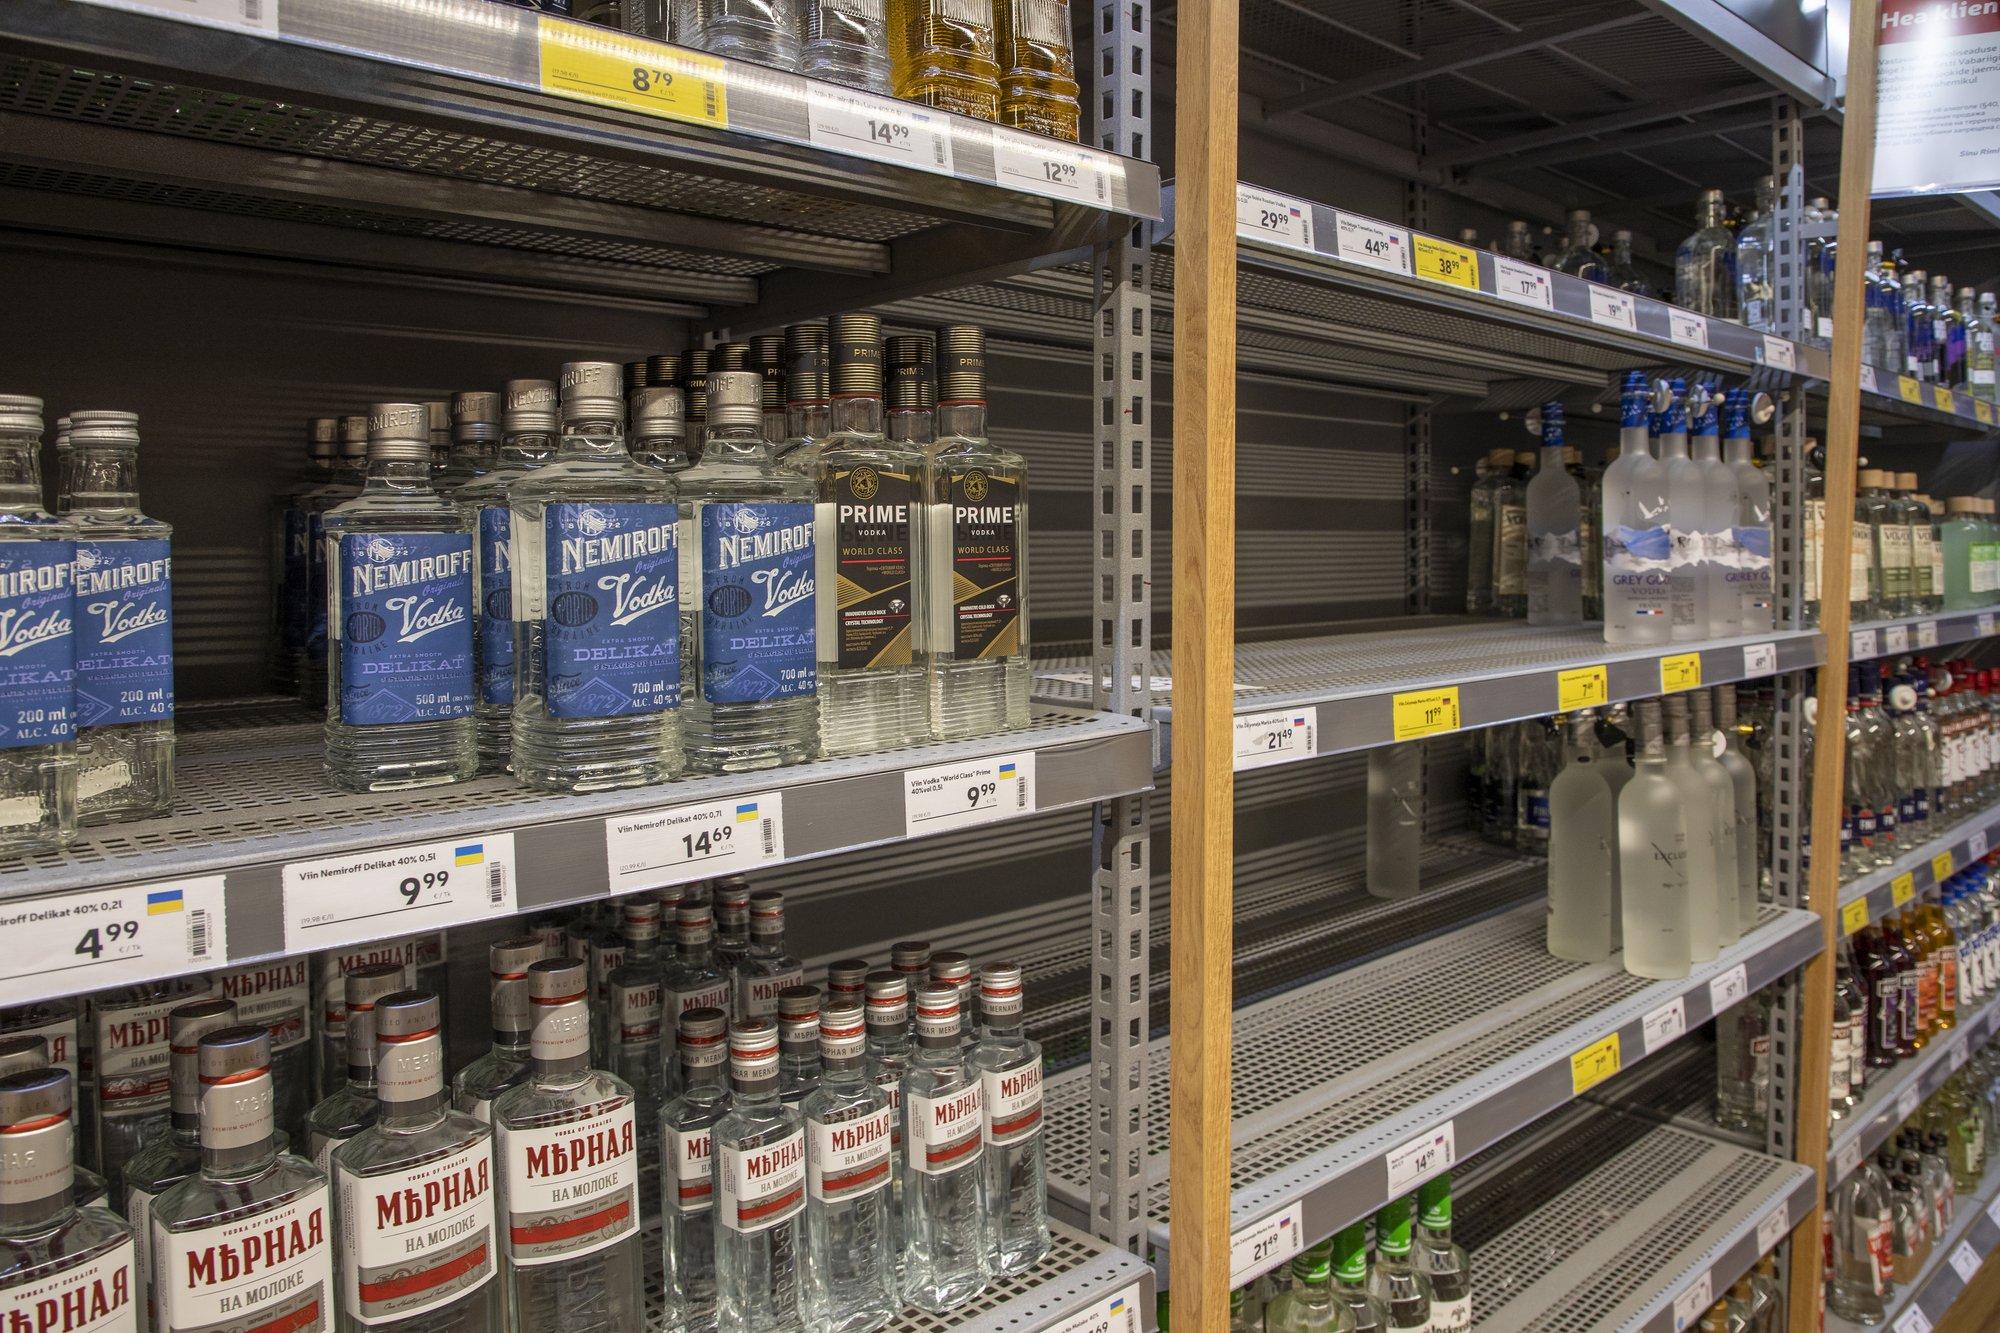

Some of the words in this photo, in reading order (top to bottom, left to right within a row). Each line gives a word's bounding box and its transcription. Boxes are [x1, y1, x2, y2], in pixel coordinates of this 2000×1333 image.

[840, 504, 907, 524] PRIME
[955, 506, 1013, 524] PRIME
[842, 547, 874, 557] WORLD
[877, 547, 903, 555] CLASS
[957, 546, 984, 555] WORLD
[987, 545, 1010, 553] CLASS
[353, 550, 472, 598] NEMIROFF
[597, 573, 676, 626] Vodka
[751, 570, 814, 617] Vodka
[87, 601, 168, 643] Vodka
[385, 596, 466, 643] Vodka
[573, 641, 676, 662] DELIKAT
[77, 655, 172, 671] ELIKAT
[362, 658, 466, 674] DELIKAT
[780, 668, 796, 680] 700
[797, 666, 807, 678] ml
[632, 681, 651, 694] 700
[652, 680, 664, 692] ml
[798, 681, 806, 690] 40
[120, 689, 144, 703] 200
[147, 688, 163, 700] ml
[416, 694, 435, 705] 500
[437, 692, 451, 703] ml
[653, 695, 663, 706] 40
[17, 709, 44, 724] 200
[48, 707, 67, 721] ml
[150, 702, 164, 714] 40
[440, 705, 451, 715] 40
[51, 723, 68, 735] 40
[618, 824, 633, 833] Viin
[634, 819, 666, 831] Nemiroff
[667, 816, 692, 826] Delikat
[693, 812, 708, 821] 40%
[300, 871, 319, 881] Viin
[321, 863, 361, 878] Nemiroff
[363, 859, 396, 871] Delikat
[397, 855, 417, 865] 40%
[30, 910, 70, 922] Delikat
[73, 904, 99, 915] 40%
[552, 1188, 570, 1203] НА
[572, 1172, 619, 1199] МОЛОКЕ
[405, 1237, 425, 1253] НА
[427, 1214, 476, 1244] МОЛОКЕ
[220, 1296, 243, 1313] НА
[246, 1269, 305, 1307] МОЛОКЕ
